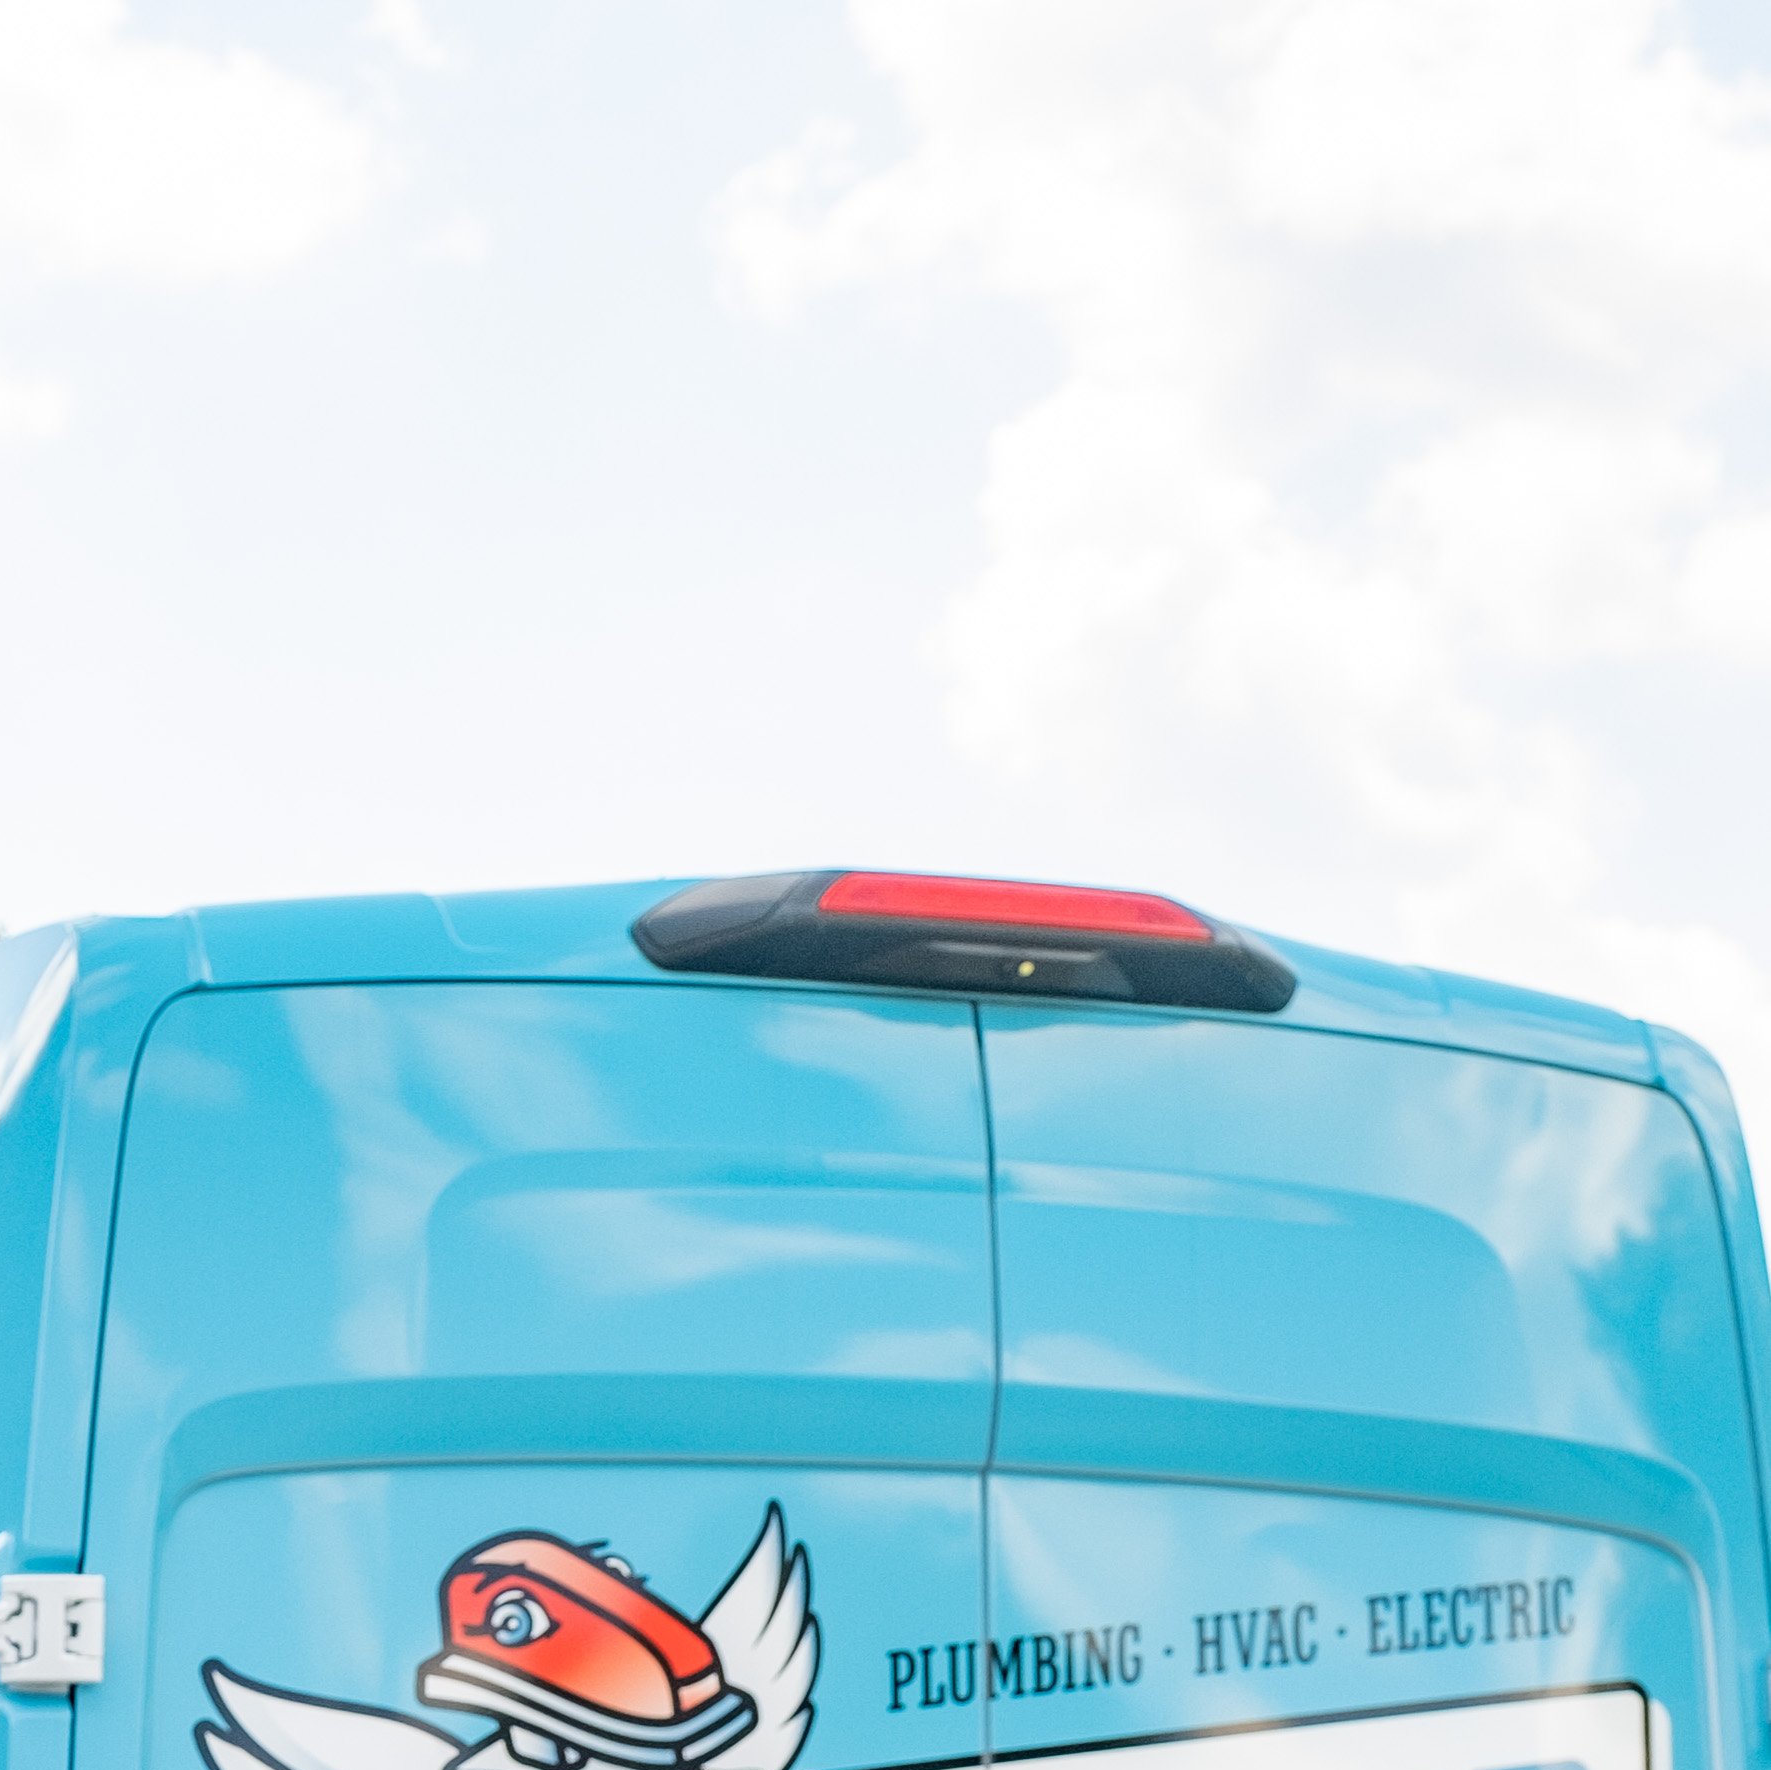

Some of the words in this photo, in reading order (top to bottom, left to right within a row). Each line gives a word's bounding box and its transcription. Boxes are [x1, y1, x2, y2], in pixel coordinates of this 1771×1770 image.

[887, 1624, 1141, 1713] PLUMBING
[1194, 1602, 1317, 1675] HVAC
[1366, 1576, 1575, 1656] ELECTRIC
